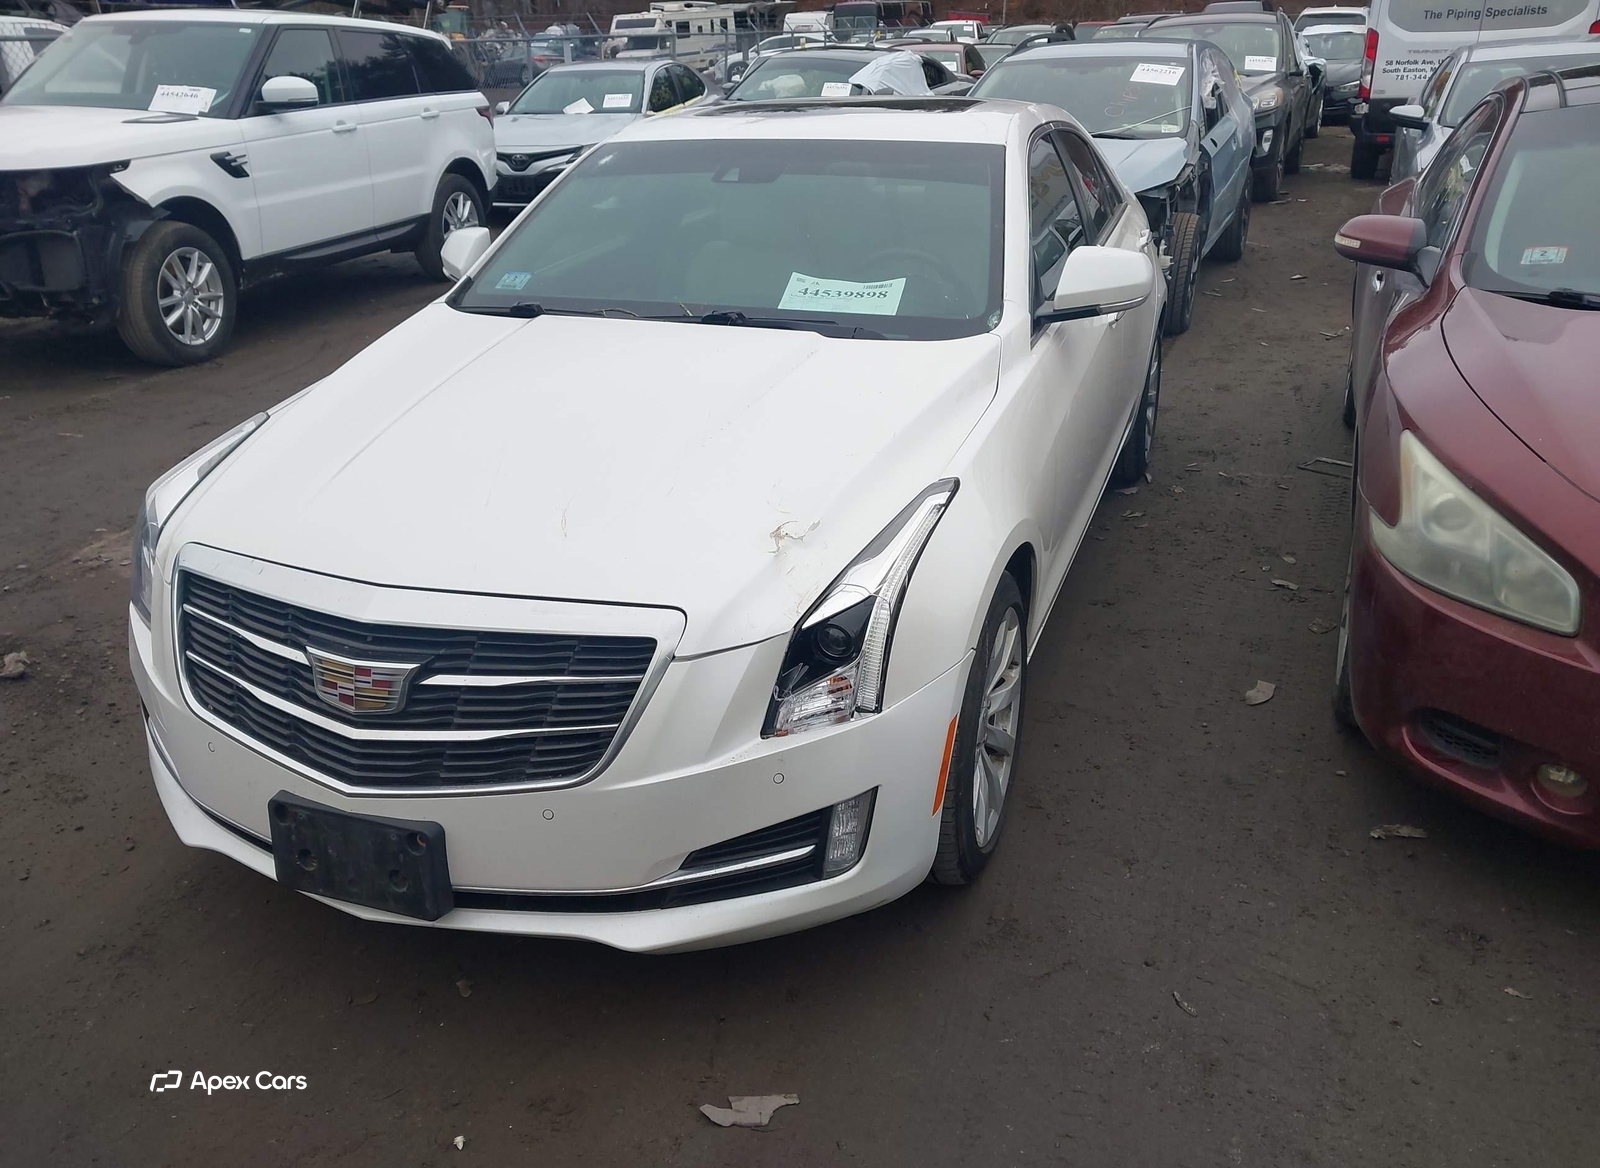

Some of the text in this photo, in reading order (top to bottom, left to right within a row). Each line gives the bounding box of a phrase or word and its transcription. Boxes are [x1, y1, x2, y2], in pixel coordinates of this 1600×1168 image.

[1423, 5, 1548, 20] The Piping Specialists
[798, 287, 889, 299] 44539898
